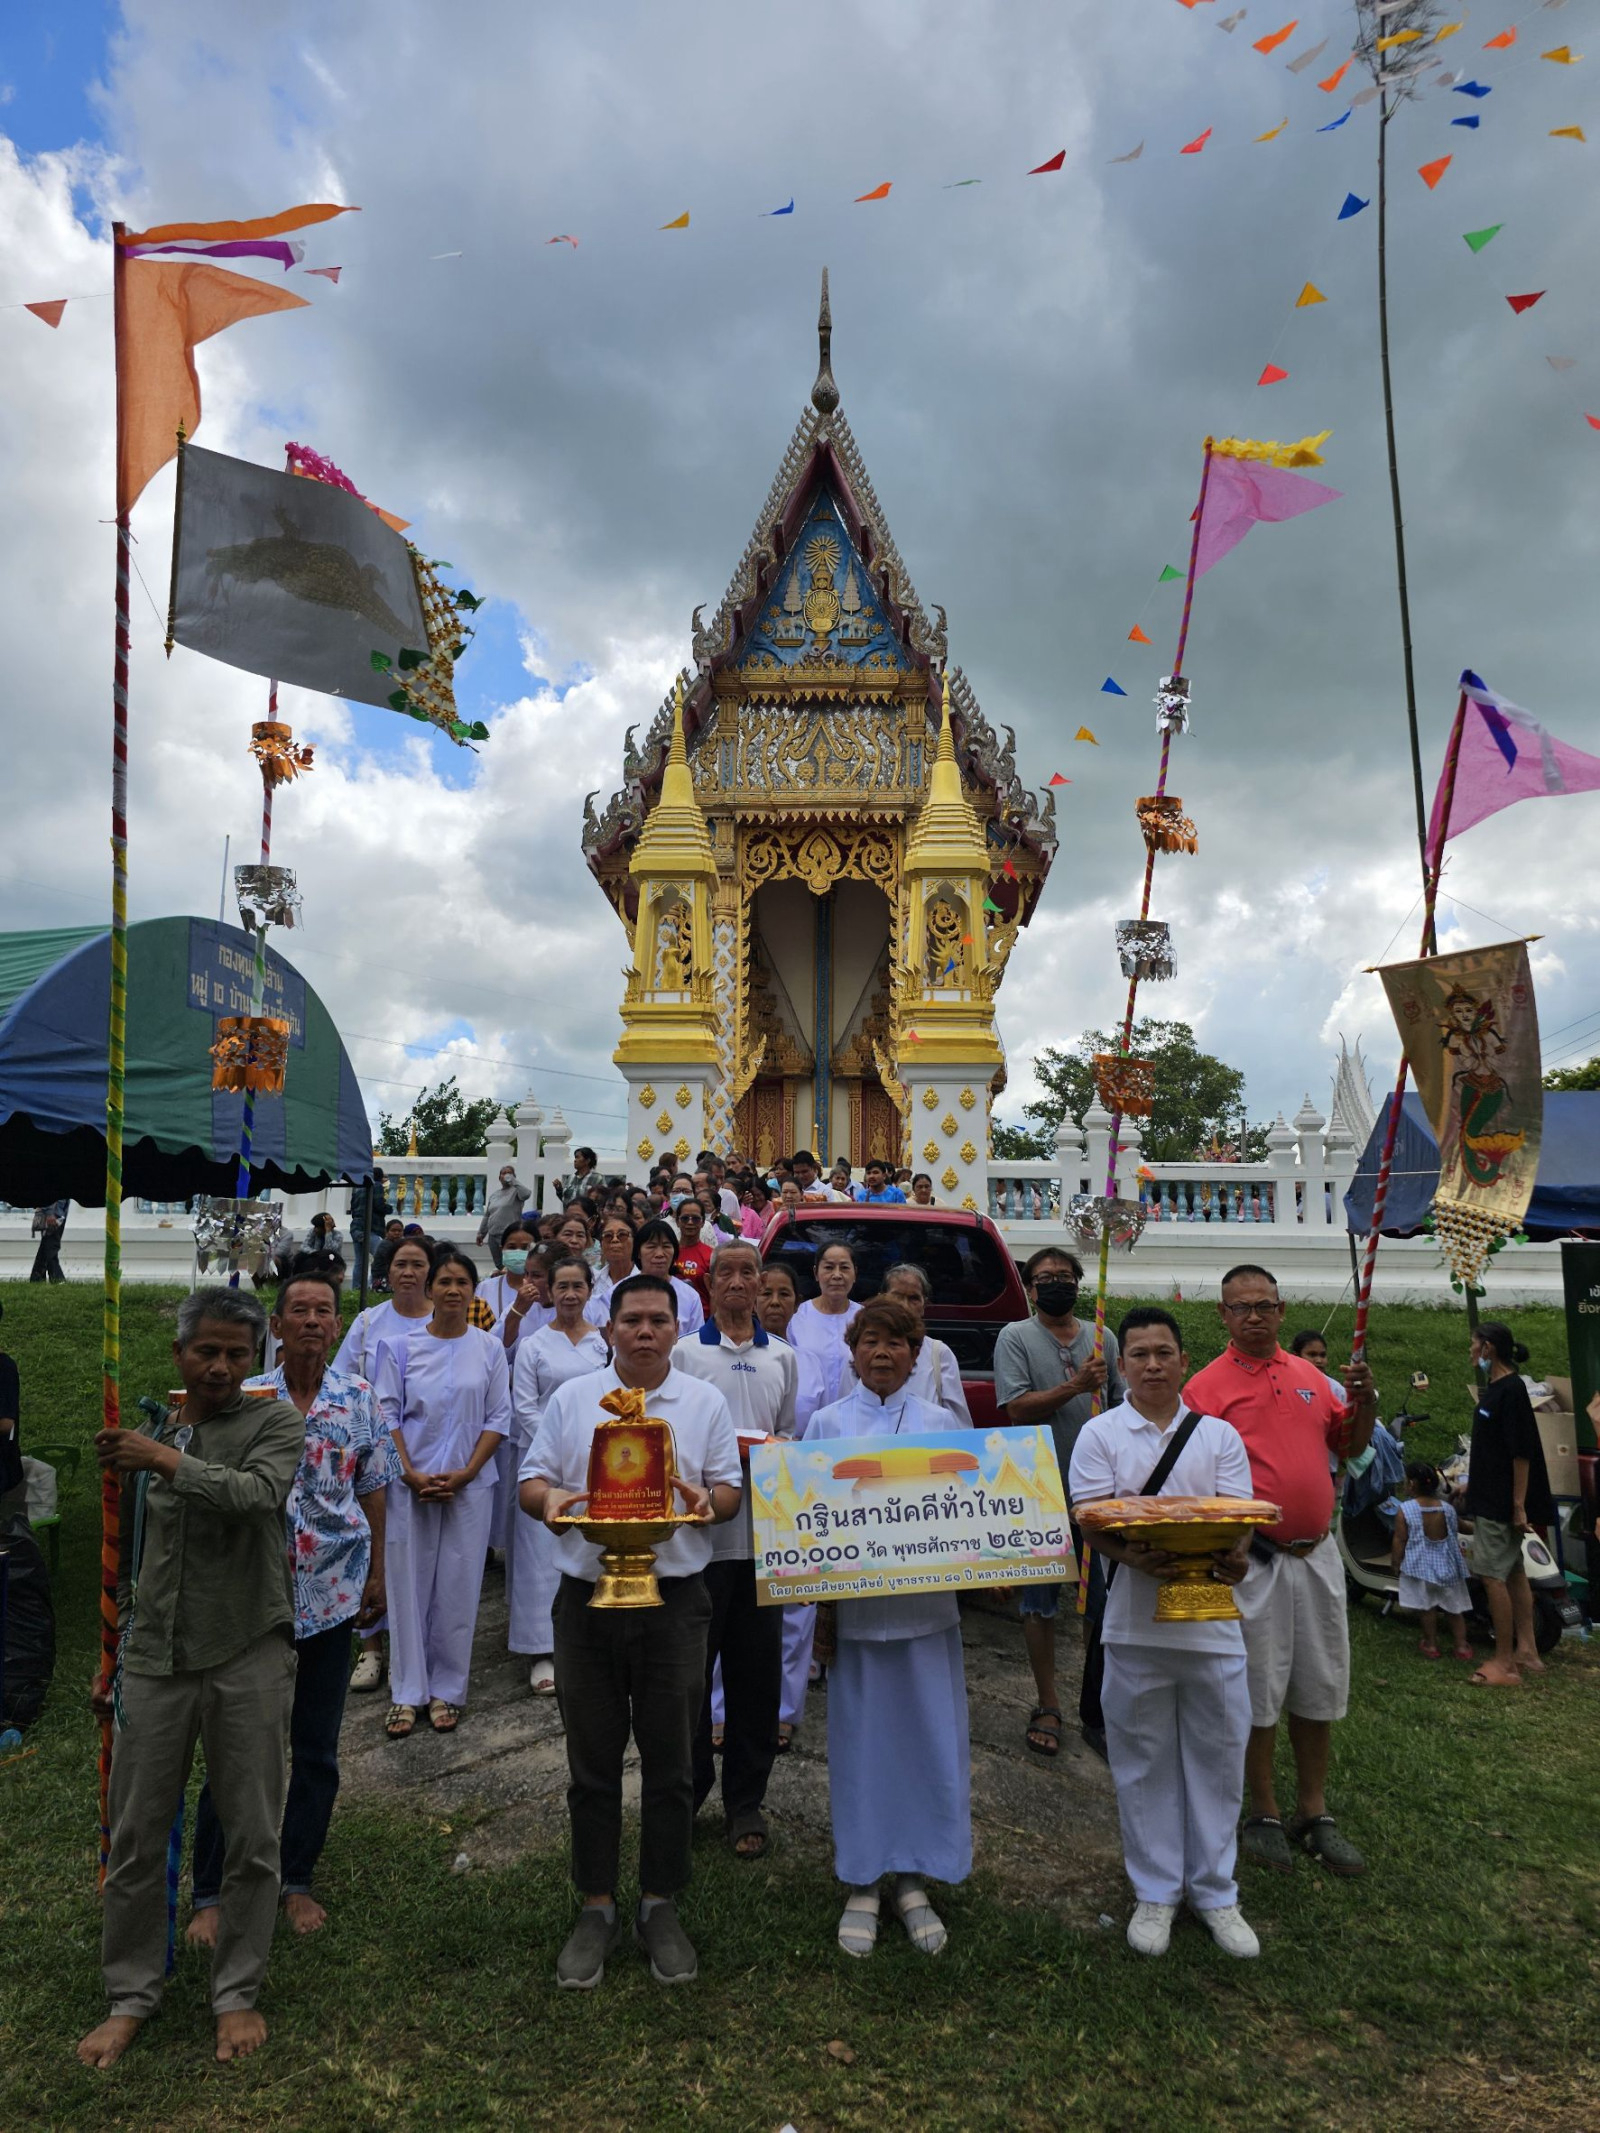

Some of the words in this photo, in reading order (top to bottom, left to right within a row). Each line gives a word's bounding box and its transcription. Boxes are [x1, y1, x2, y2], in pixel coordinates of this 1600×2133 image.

[731, 1361, 757, 1373] adidas
[796, 1486, 1025, 1537] กฐินสามัคคีทั่วไทย
[765, 1544, 860, 1568] ๓๐,๐๐๐
[867, 1540, 887, 1558] วัด
[892, 1536, 981, 1562] พุทธศักราช
[987, 1527, 1064, 1550] ๒๕๖๘
[769, 1584, 792, 1596] โดย
[796, 1574, 883, 1594] คณะศิษยานุศิษย์
[887, 1573, 940, 1590] บูชาธรรม
[965, 1568, 973, 1581] ปี
[976, 1562, 1066, 1580] หลวงพ่อธัมมชโย
